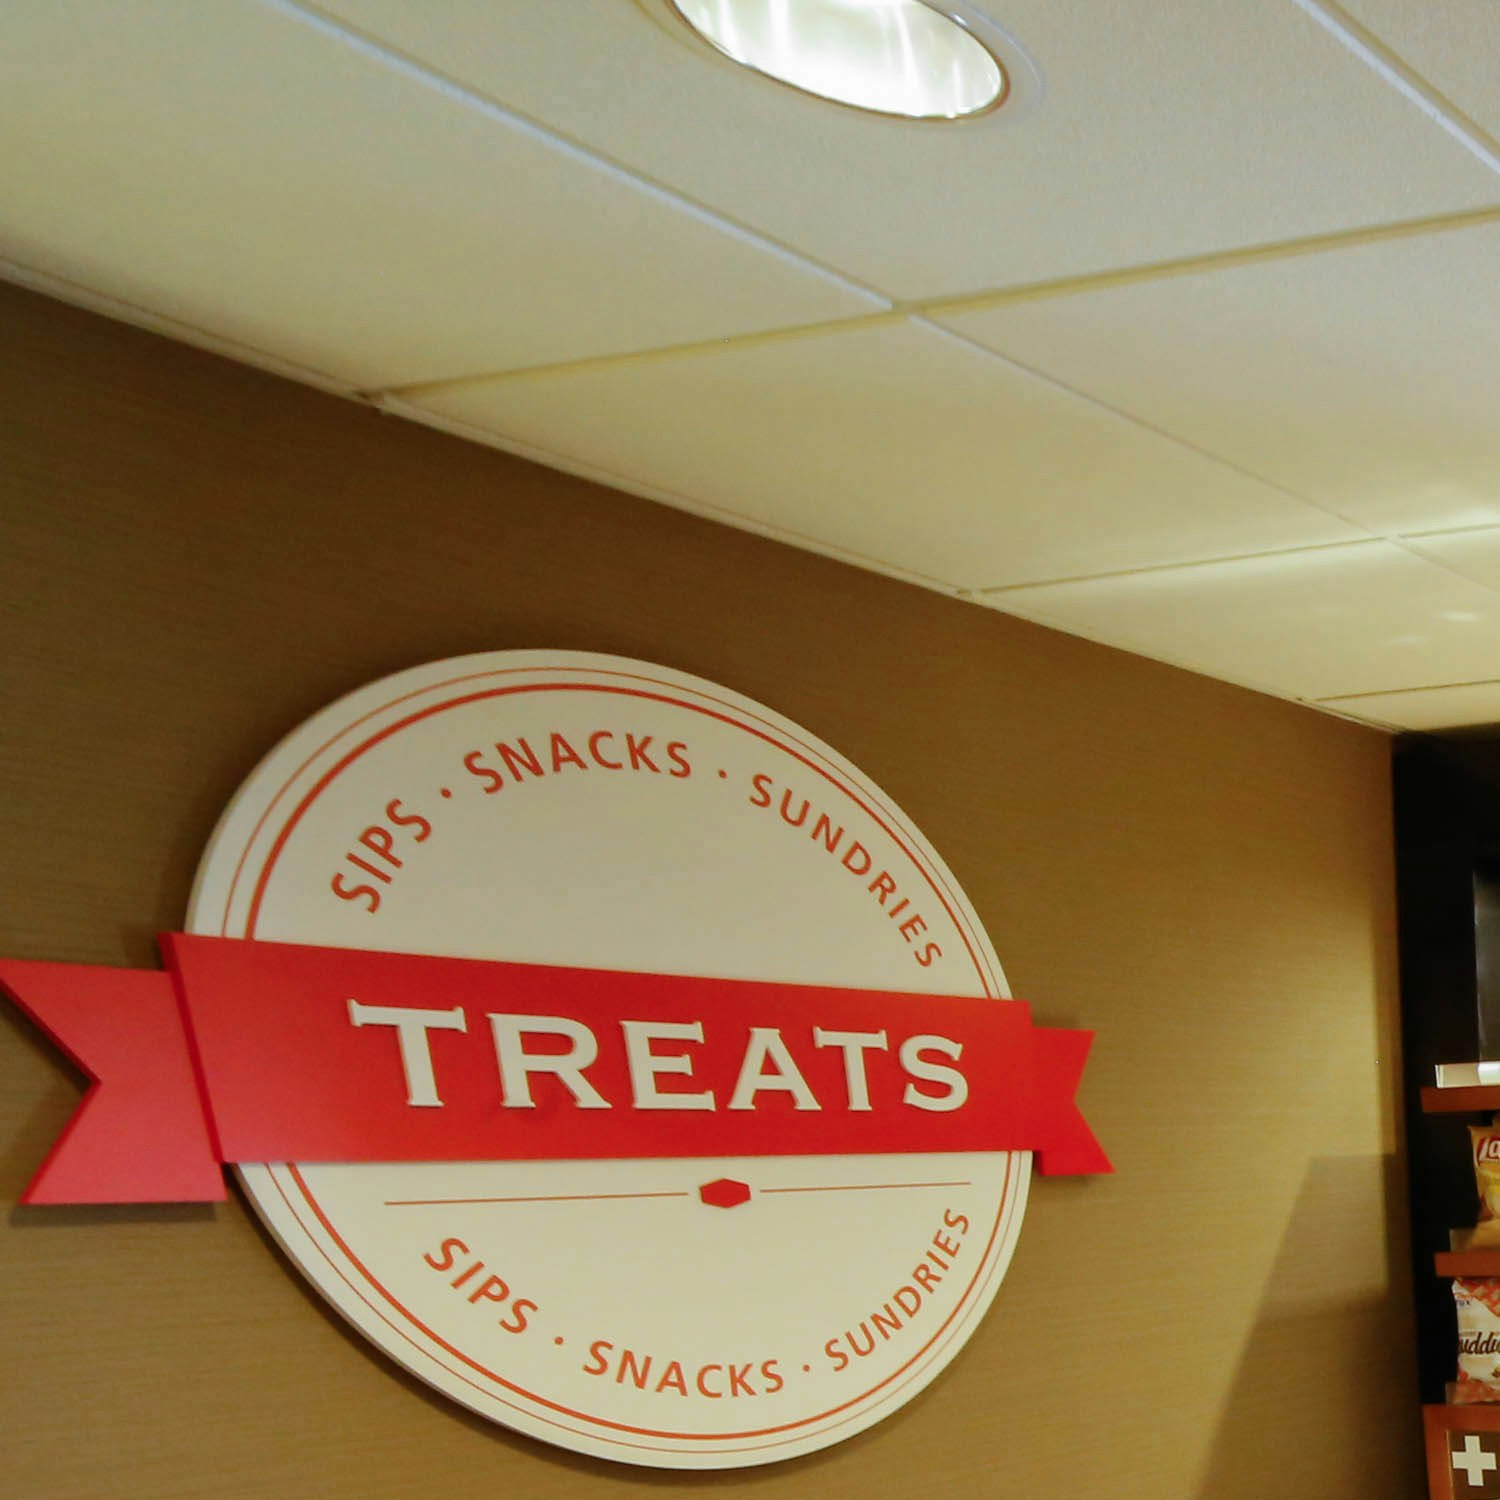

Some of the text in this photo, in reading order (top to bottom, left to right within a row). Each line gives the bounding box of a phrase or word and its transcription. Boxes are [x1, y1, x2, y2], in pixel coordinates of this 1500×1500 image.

[331, 730, 944, 969] SIPS SNACKS SUNDRIES
[346, 998, 970, 1114] TREATS
[423, 1208, 970, 1398] SIPS SNACKS SUNDRIES
